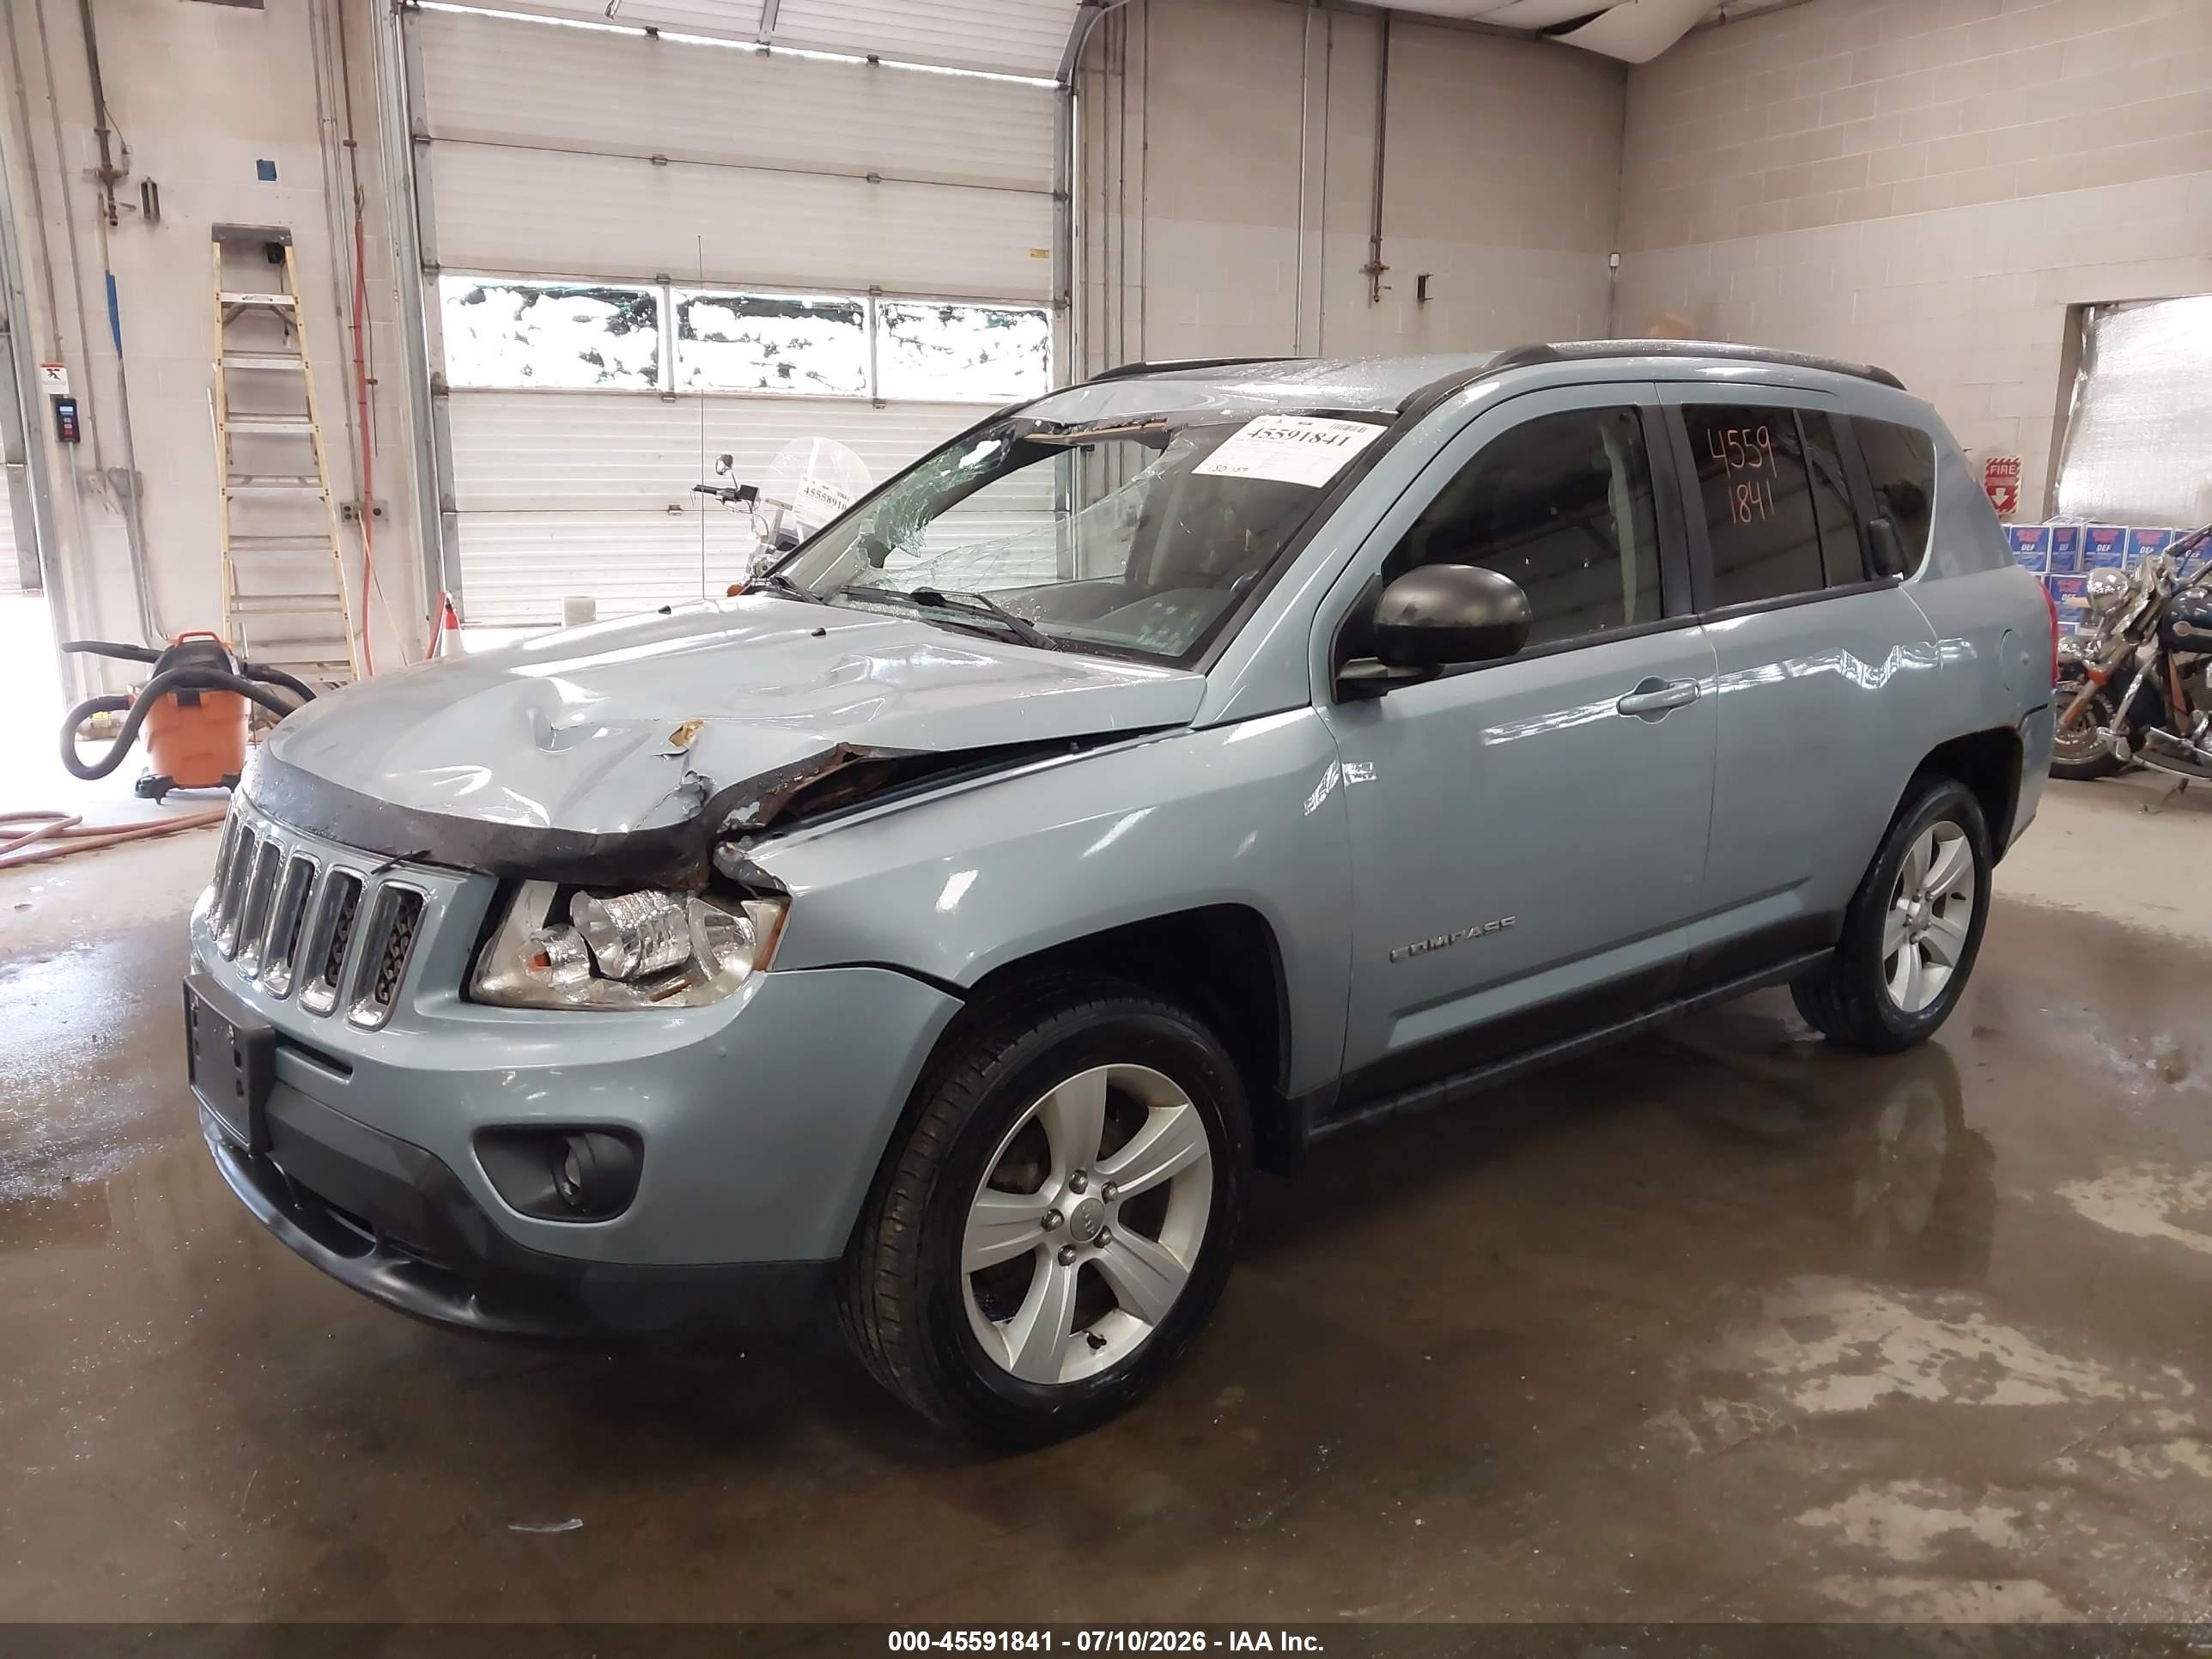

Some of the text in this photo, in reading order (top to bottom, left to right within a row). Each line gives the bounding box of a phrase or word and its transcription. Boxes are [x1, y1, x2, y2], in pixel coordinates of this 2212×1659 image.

[1248, 427, 1352, 447] 45591841
[1706, 425, 1778, 479] 4559
[1990, 465, 2017, 475] FIRE
[1728, 478, 1776, 525] 1841
[2096, 544, 2112, 552] DEF
